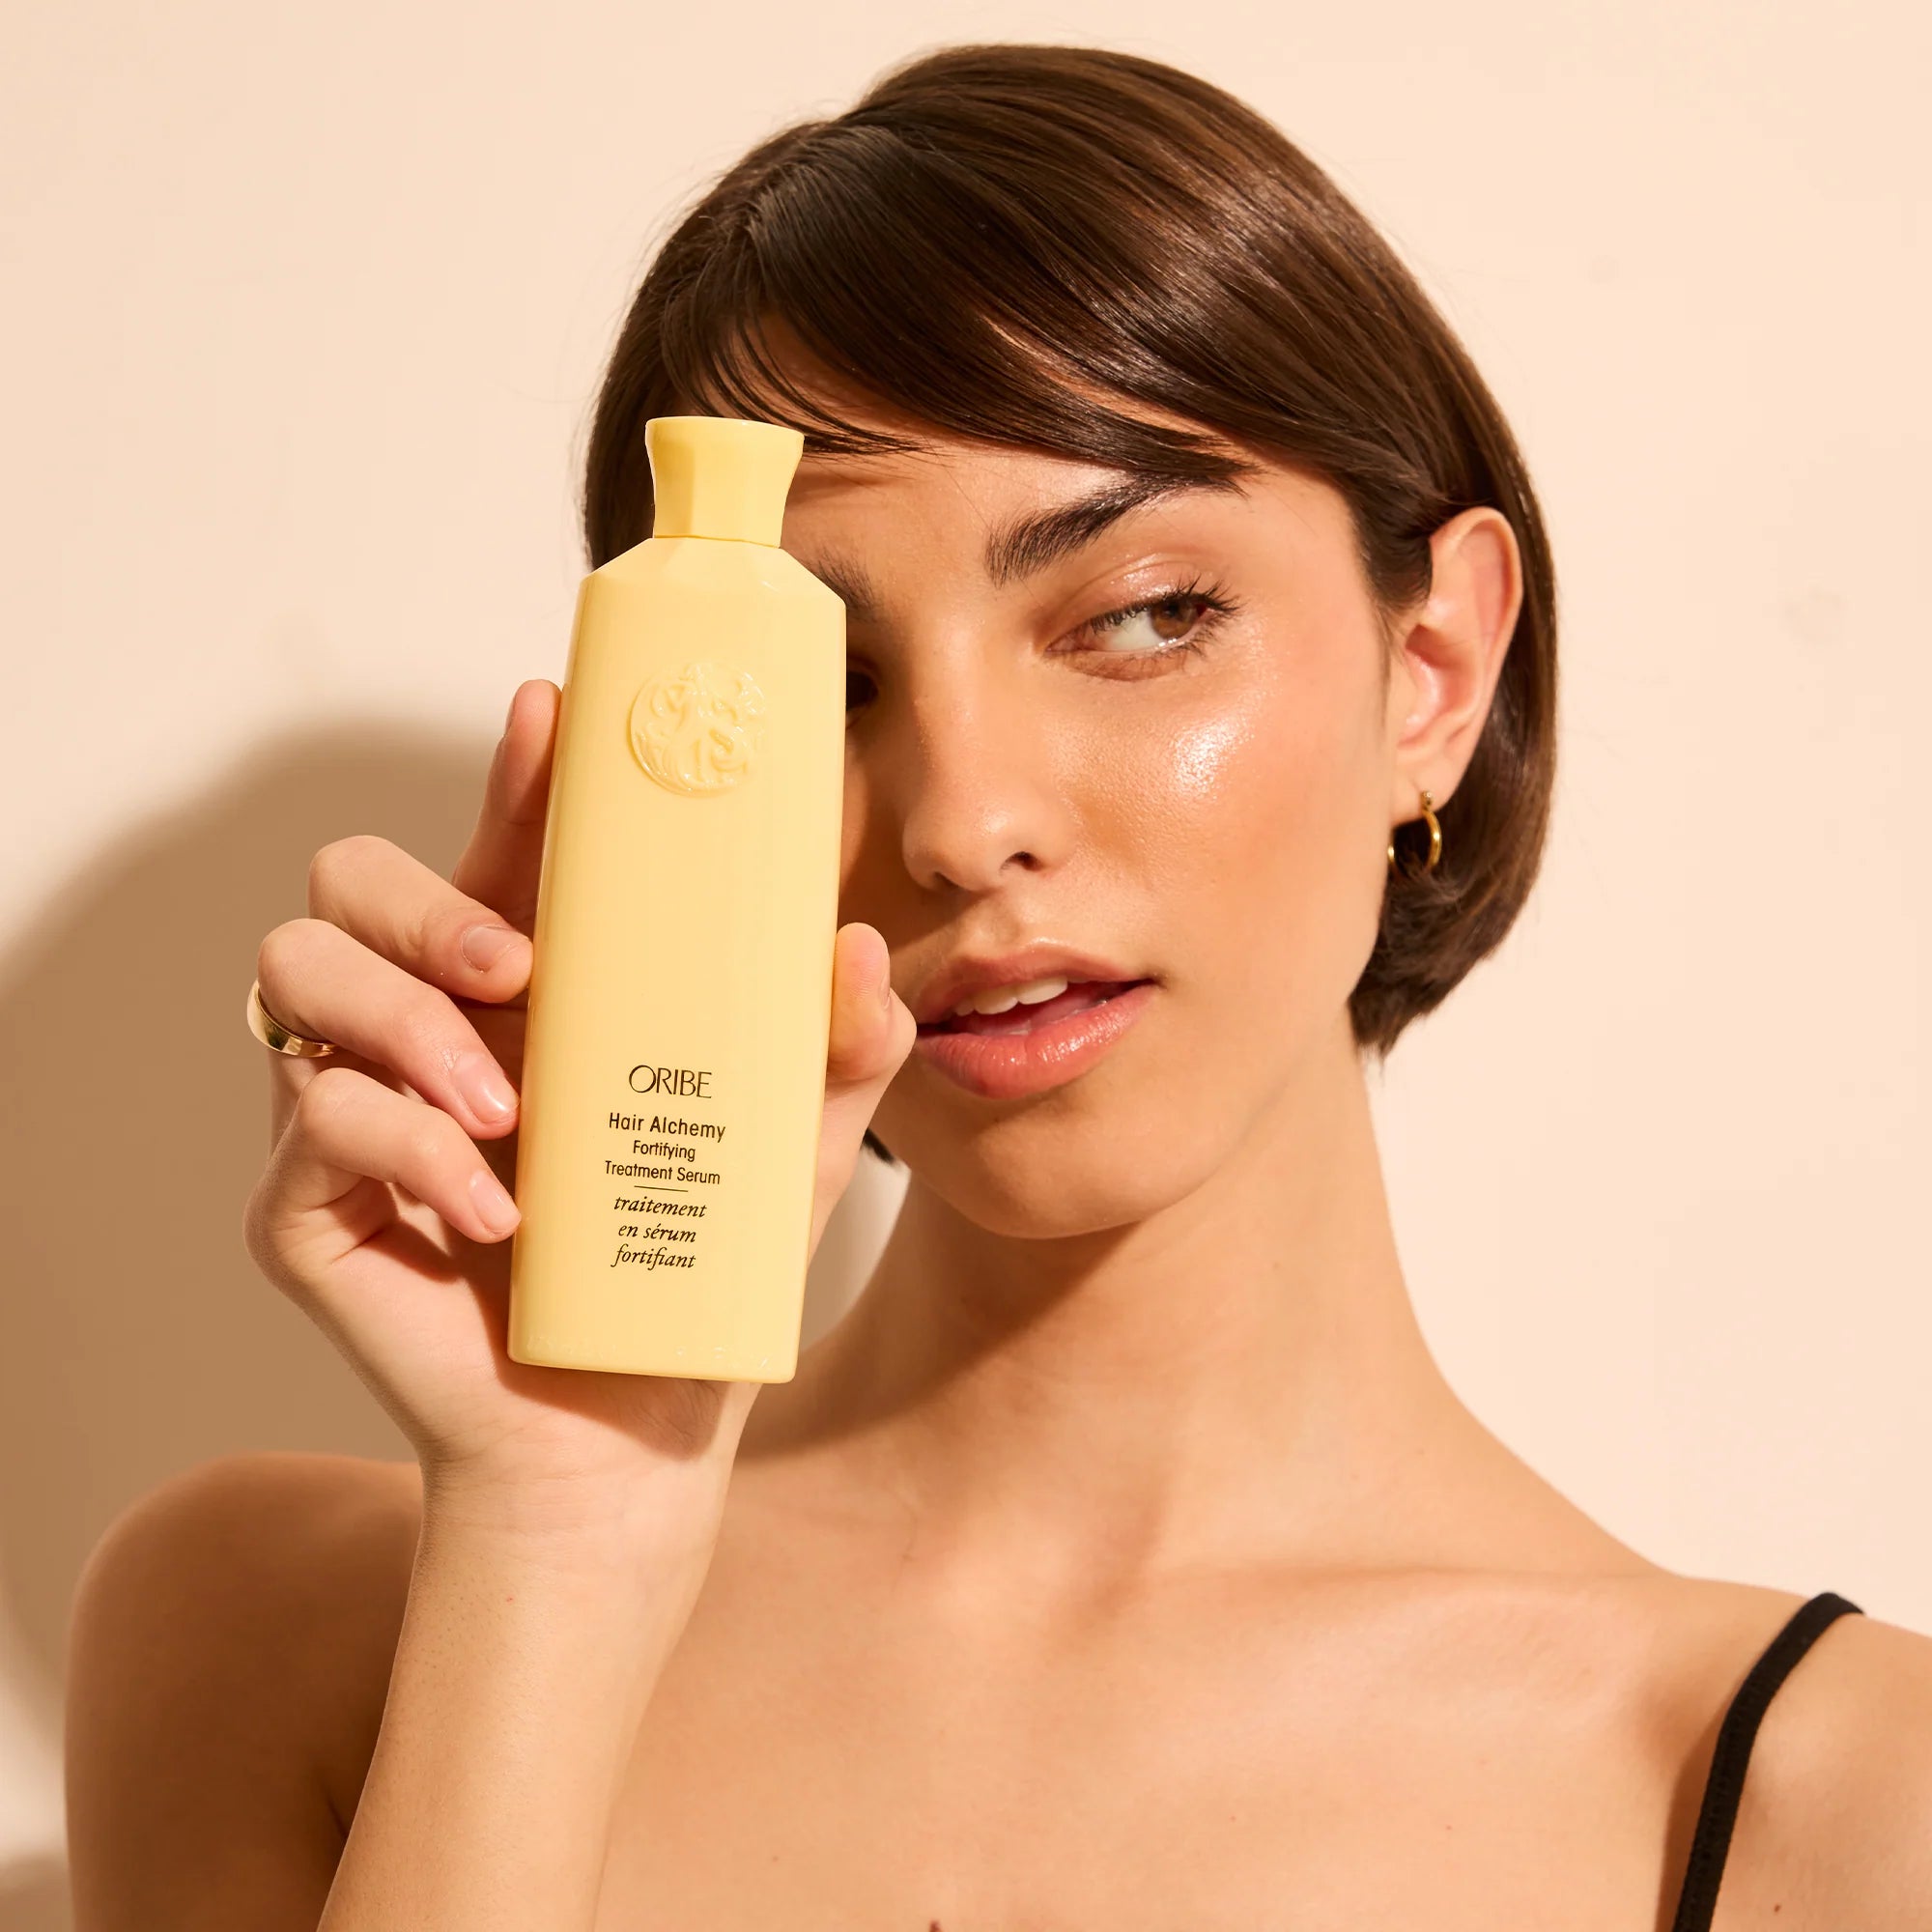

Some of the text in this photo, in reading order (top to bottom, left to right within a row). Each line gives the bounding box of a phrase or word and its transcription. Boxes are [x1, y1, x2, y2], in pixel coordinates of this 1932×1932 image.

[629, 1065, 712, 1098] ORIBE
[610, 1112, 725, 1143] Hair Alchemy
[633, 1140, 696, 1162] Fortifying
[605, 1160, 720, 1184] Treatment Serum
[614, 1197, 707, 1218] traitement
[618, 1223, 696, 1242] en sérum
[611, 1243, 696, 1270] fortifiant
